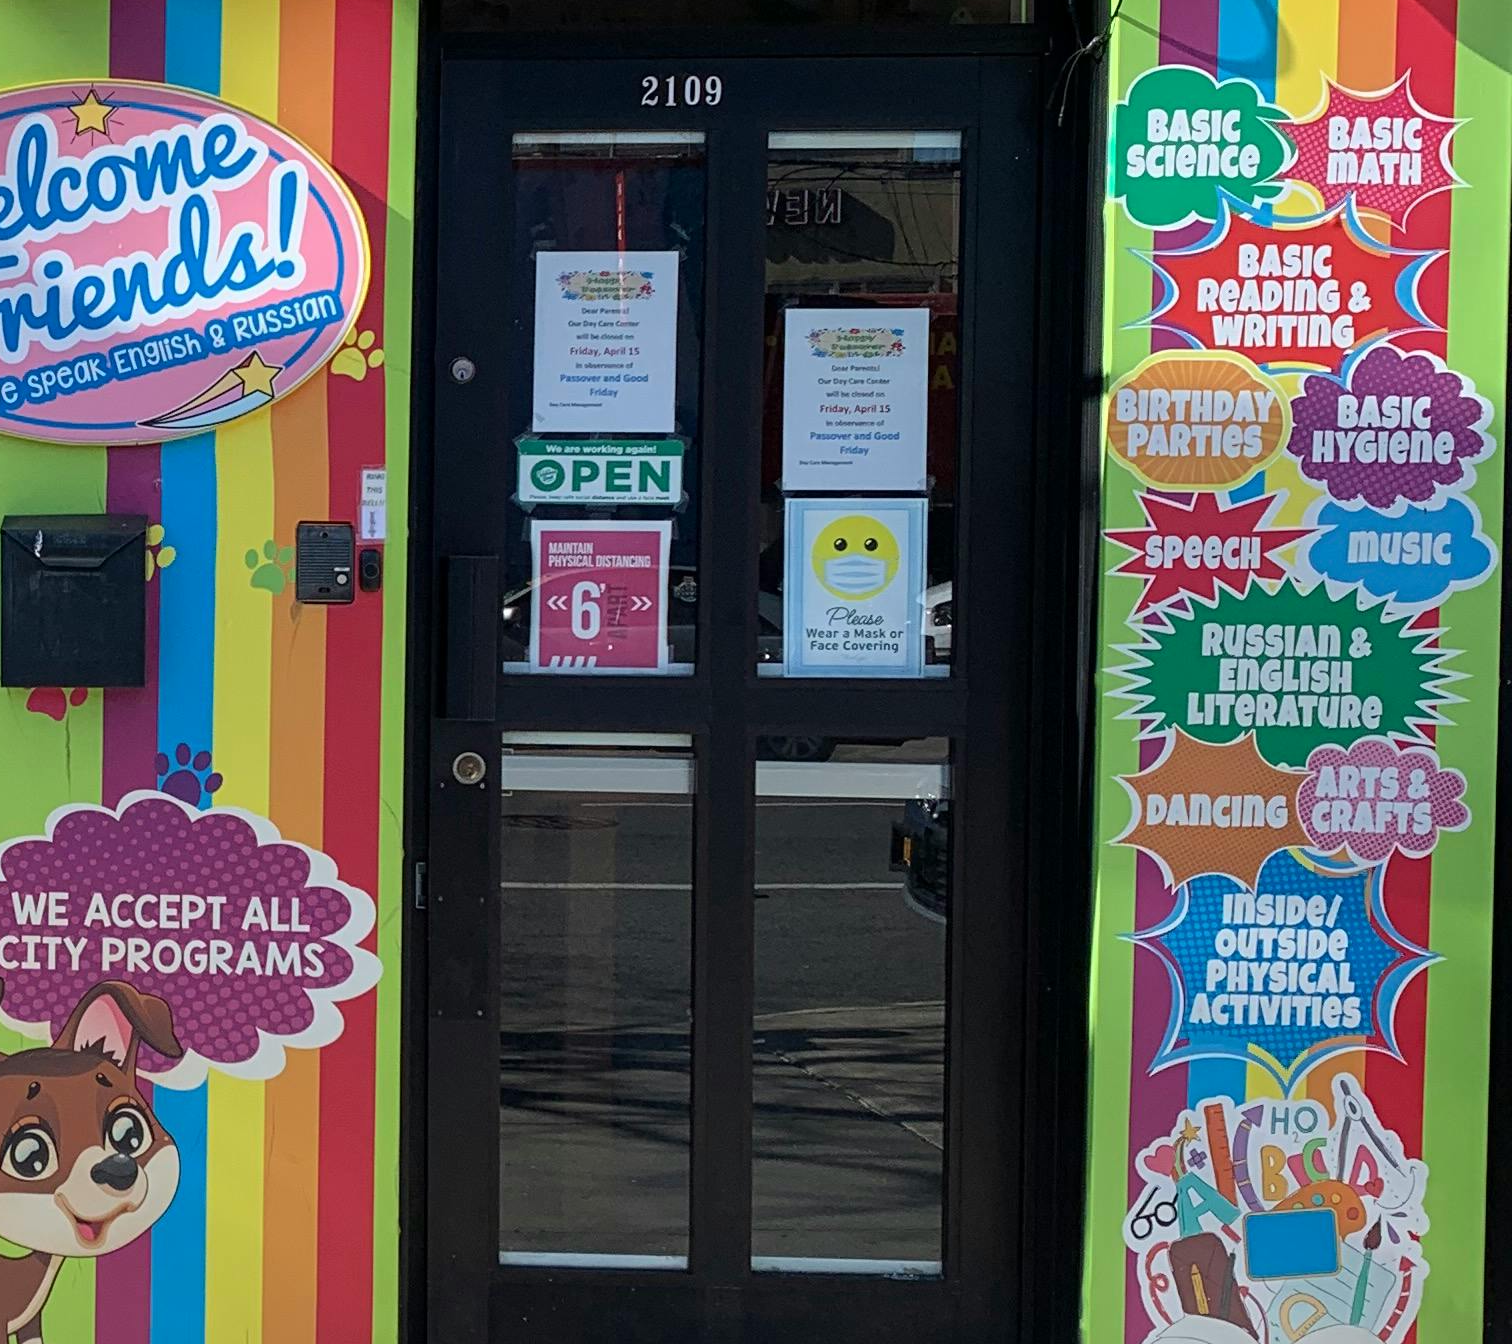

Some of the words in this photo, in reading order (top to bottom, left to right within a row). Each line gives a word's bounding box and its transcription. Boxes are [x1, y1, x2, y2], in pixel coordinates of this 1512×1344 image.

[641, 75, 723, 108] 2109
[1147, 109, 1241, 143] BASIC
[1328, 116, 1423, 151] BASIC
[1327, 151, 1422, 185] MATH
[1238, 244, 1333, 279] BASIC
[1347, 281, 1372, 314] &
[30, 359, 107, 400] speak
[211, 324, 226, 351] &
[234, 294, 338, 344] Russian
[1211, 314, 1355, 349] WRITING
[569, 347, 601, 357] Friday,
[603, 347, 626, 357] April
[629, 347, 640, 355] 15
[560, 374, 601, 383] Passover
[603, 374, 621, 383] and
[623, 374, 649, 383] Good
[590, 388, 618, 398] Friday
[819, 405, 851, 414] Friday,
[854, 405, 877, 414] April
[879, 405, 890, 413] 15
[1116, 388, 1276, 423] BIRTHDAY
[1337, 395, 1432, 430] BASIC
[545, 444, 562, 453] We
[582, 444, 624, 455] working
[625, 444, 657, 455] again!
[810, 432, 851, 441] Passover
[854, 432, 872, 441] and
[874, 432, 900, 441] Good
[840, 446, 870, 456] Friday
[1127, 423, 1263, 458] PARTIES
[530, 459, 671, 493] OPEN
[548, 542, 593, 555] MAINTAIN
[548, 555, 594, 568] PHYSICAL
[596, 555, 651, 568] DISTANCING
[1347, 531, 1453, 566] MUSIC
[806, 628, 839, 638] Wear
[842, 630, 850, 638] a
[854, 628, 886, 638] Mask
[890, 630, 904, 638] or
[826, 607, 884, 626] Please
[810, 641, 839, 651] Face
[843, 641, 899, 653] Covering
[1201, 622, 1342, 658] RUSSIAN
[1348, 626, 1372, 659] &
[1218, 658, 1352, 693] ENGLISH
[1315, 765, 1400, 799] ARTS
[1406, 768, 1430, 800] &
[1146, 794, 1289, 828] DANCING
[1312, 800, 1433, 835] CRAFTS
[11, 892, 69, 927] WE
[84, 893, 227, 930] ACCEPT
[242, 897, 310, 933] ALL
[102, 938, 326, 977] PROGRAMS
[1214, 927, 1349, 962] OUTSIDE
[1206, 961, 1355, 995] PHYSICAL
[1188, 993, 1361, 1029] ACTIVITIES
